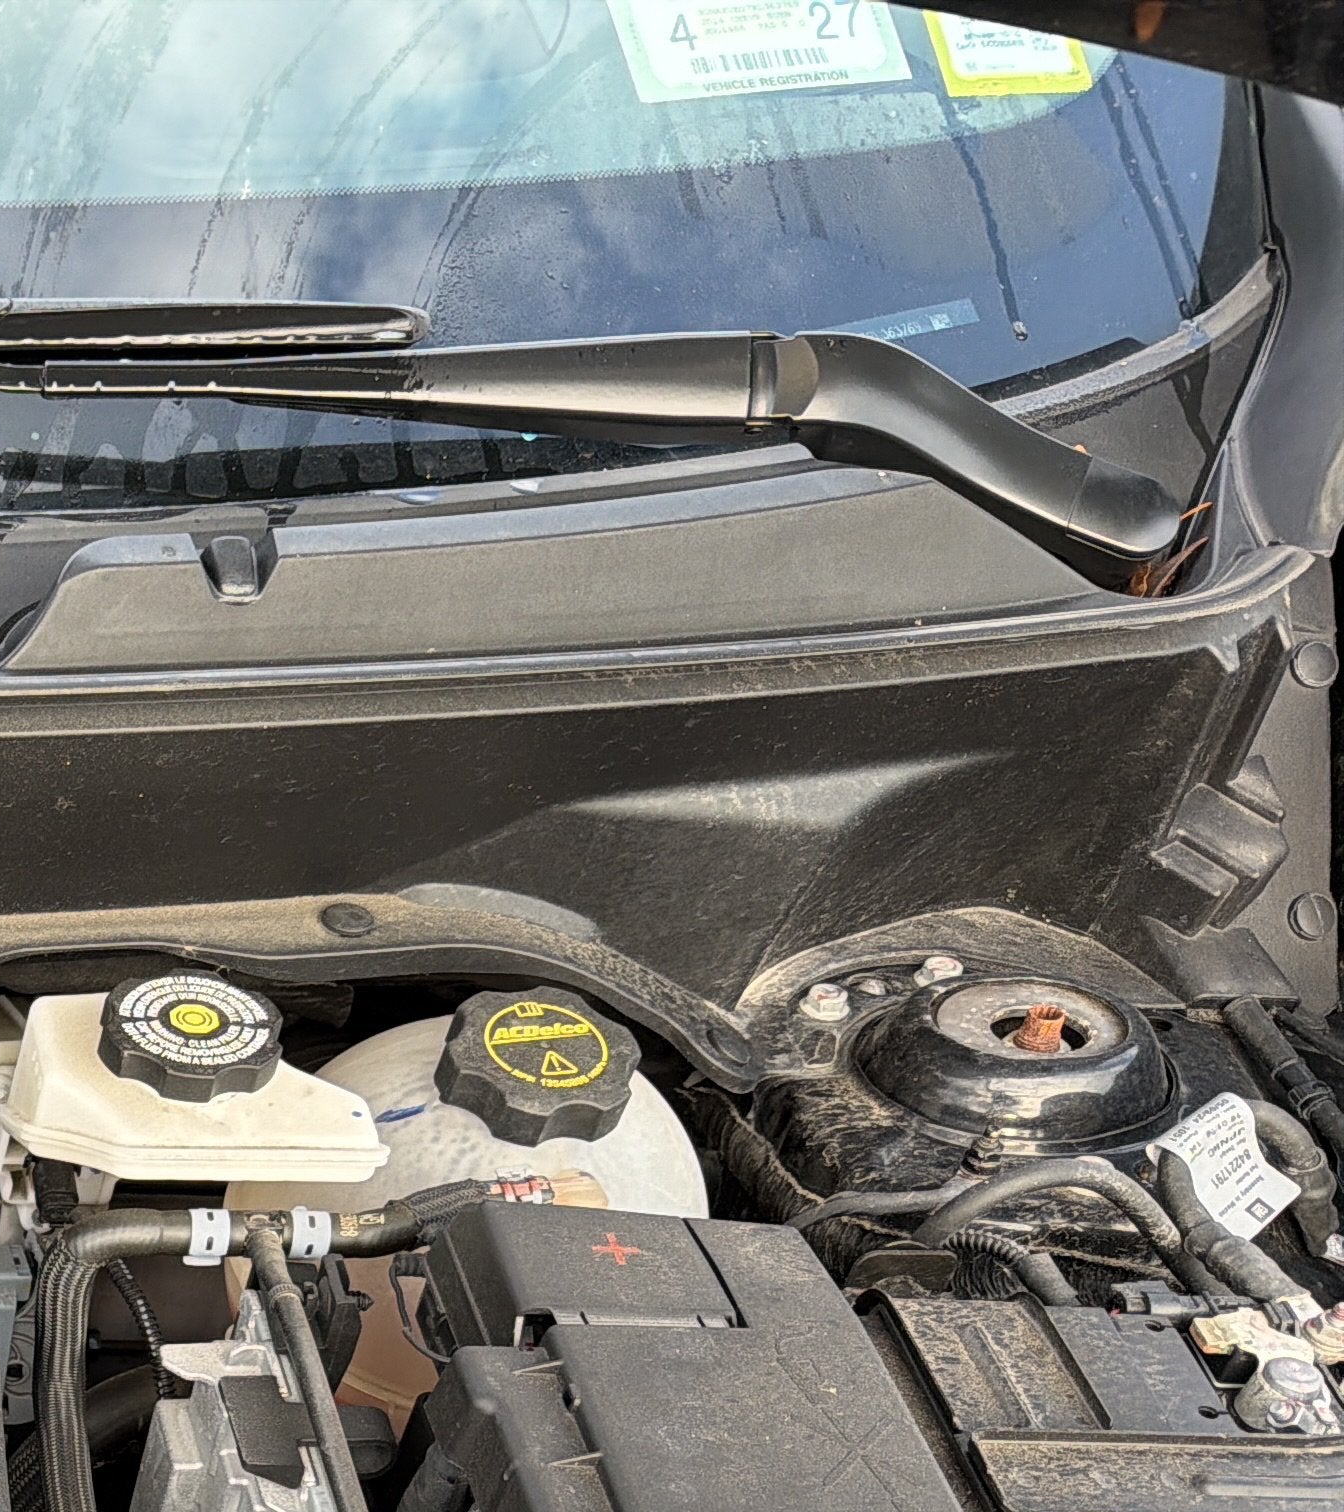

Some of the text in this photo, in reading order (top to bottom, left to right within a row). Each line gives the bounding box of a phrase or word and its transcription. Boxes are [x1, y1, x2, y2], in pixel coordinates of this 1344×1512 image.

[669, 0, 860, 50] 4 27
[702, 70, 849, 93] VEHICLE REGISTRATION
[186, 1037, 223, 1048] CLEAN
[493, 1022, 589, 1040] ACDelco
[131, 1036, 164, 1057] FLUID
[158, 1050, 191, 1065] FROM
[199, 1051, 240, 1065] SEALED
[1210, 1148, 1252, 1190] 84221791
